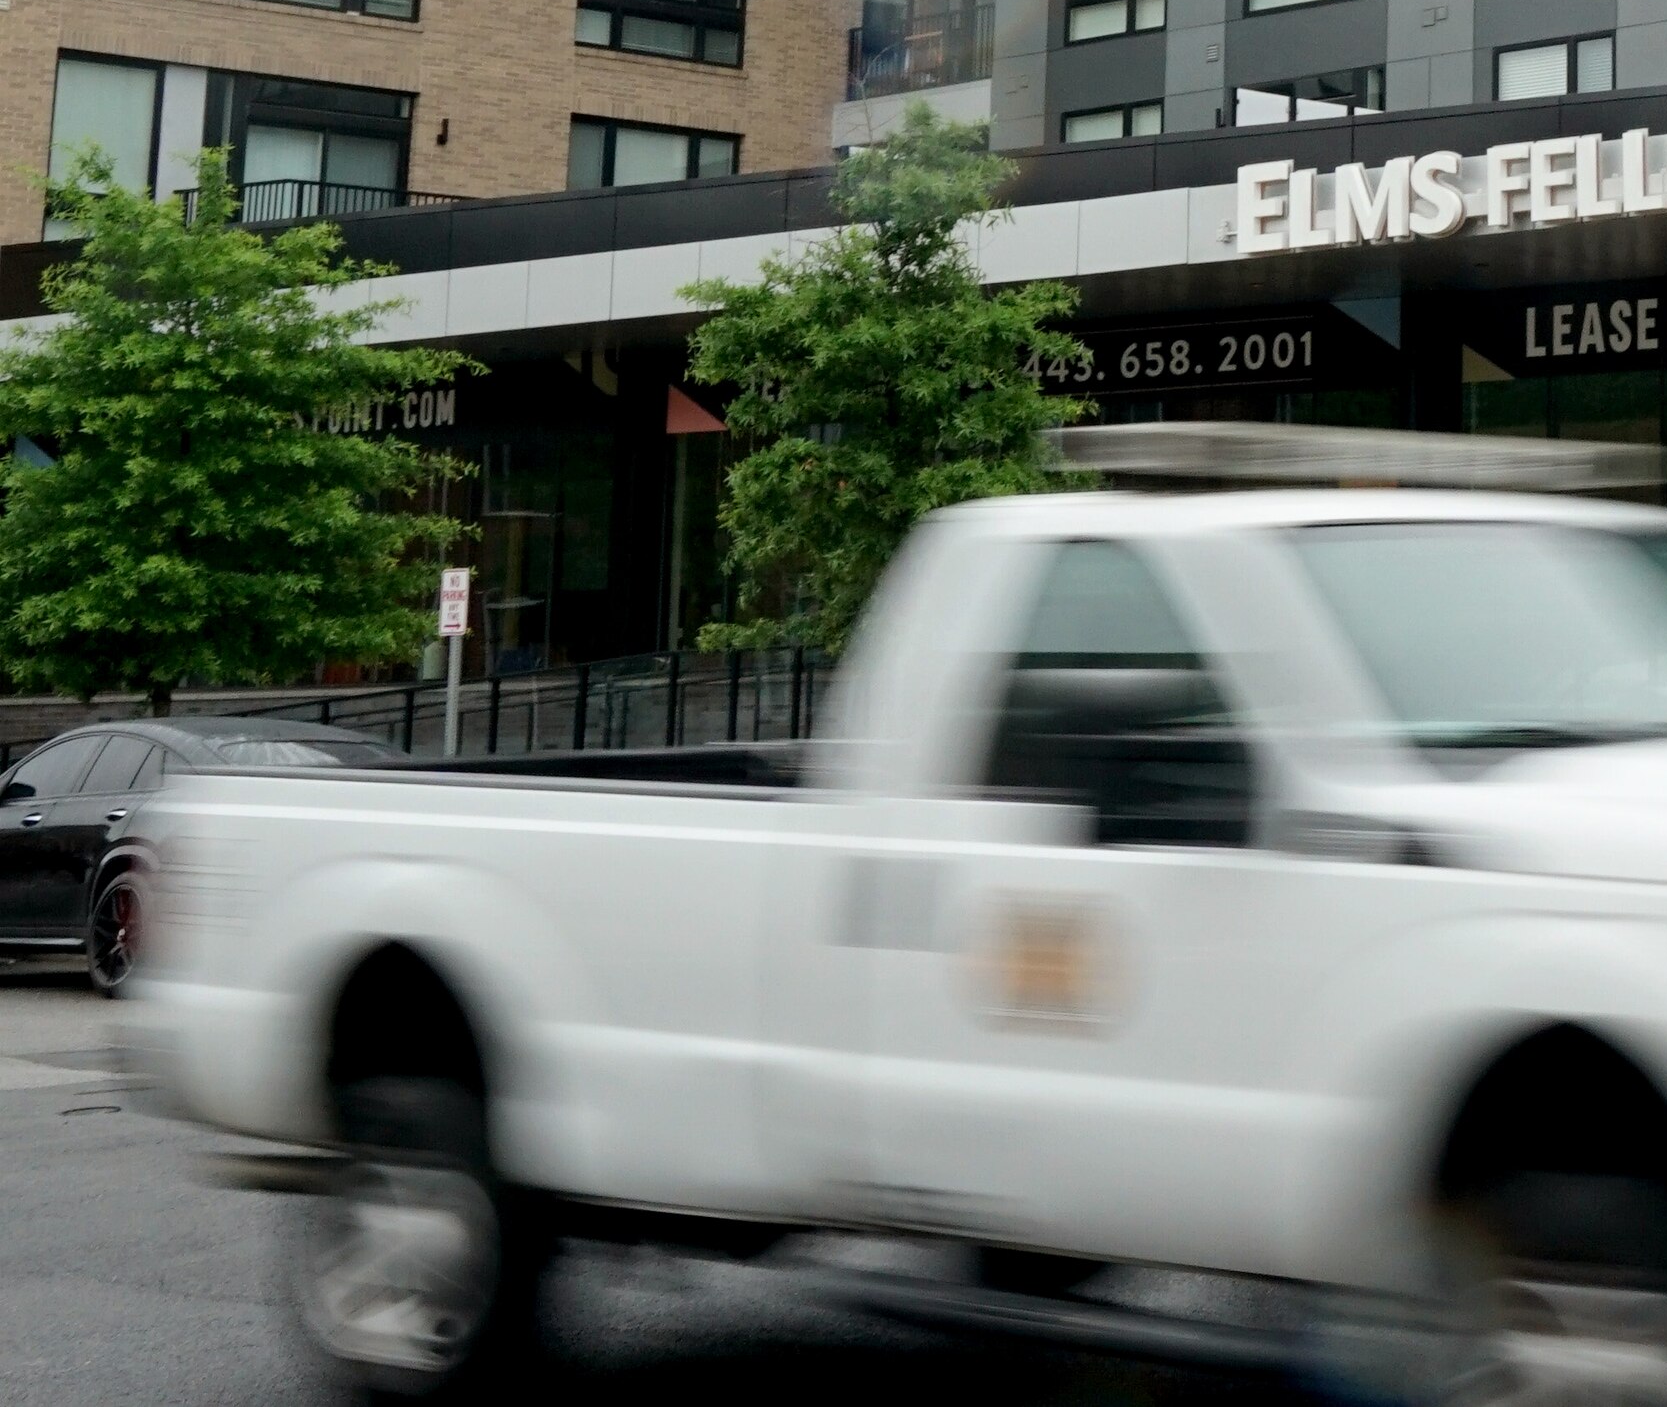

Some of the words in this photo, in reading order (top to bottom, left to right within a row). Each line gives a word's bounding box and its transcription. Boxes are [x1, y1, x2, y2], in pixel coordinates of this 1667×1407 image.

[1237, 150, 1466, 255] ELMS
[1218, 331, 1312, 372] 2001
[1526, 298, 1659, 358] LEASE
